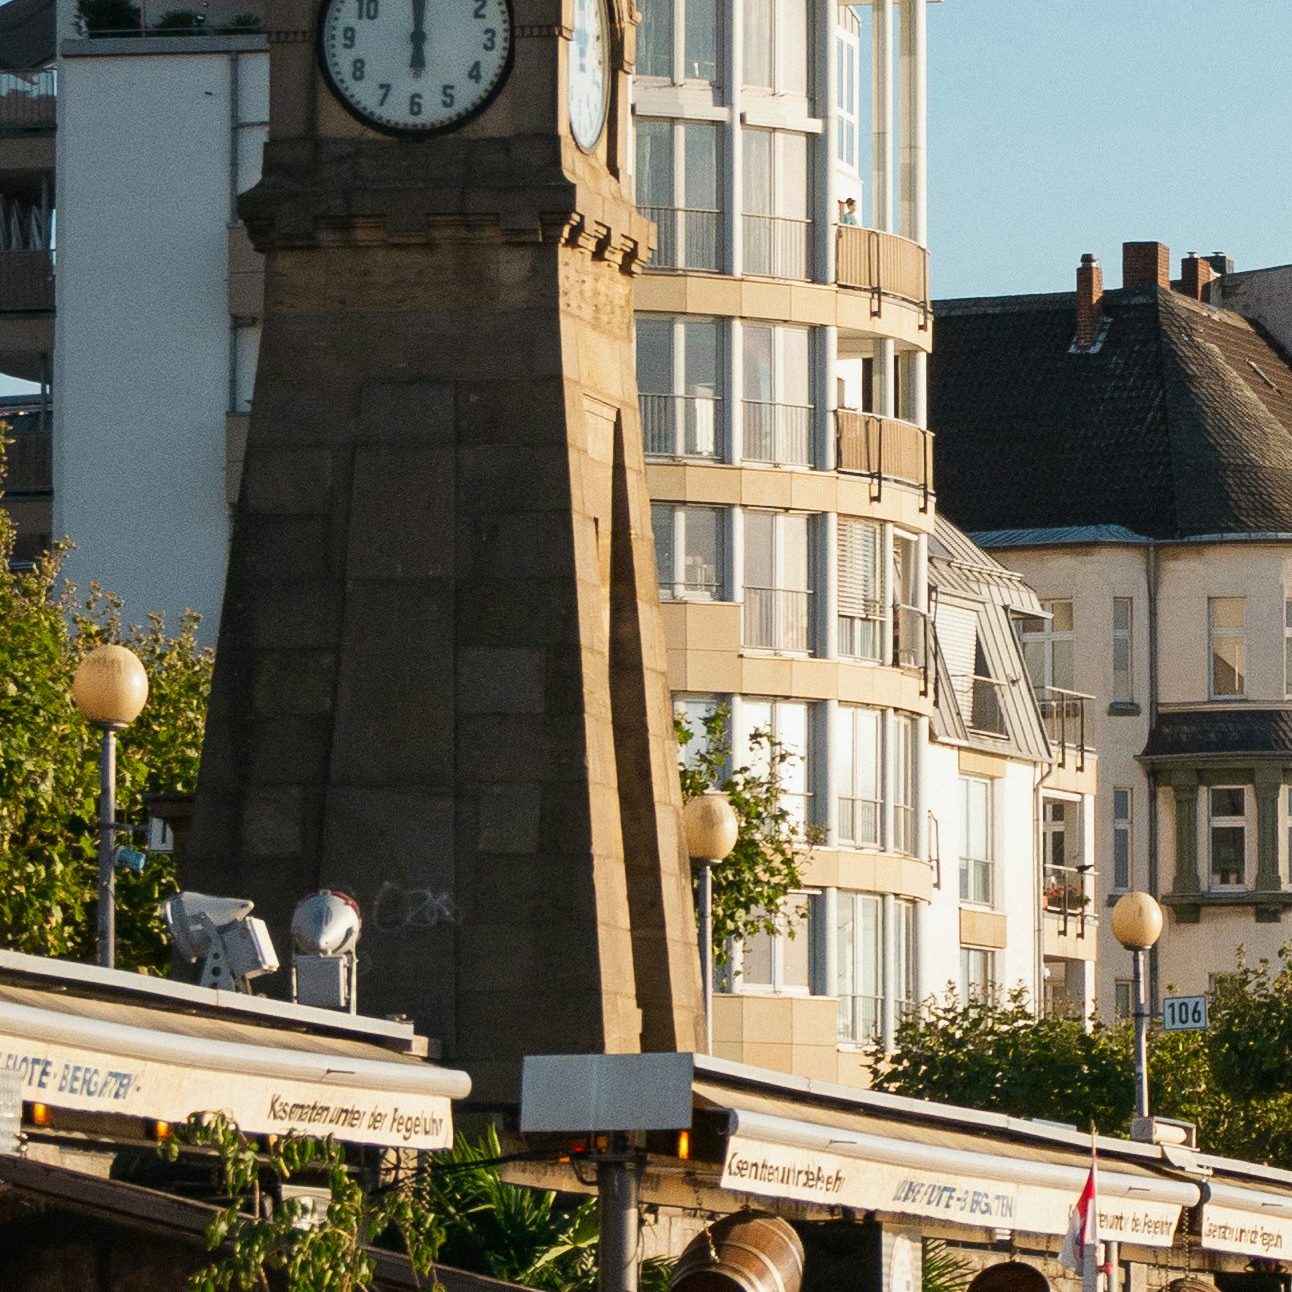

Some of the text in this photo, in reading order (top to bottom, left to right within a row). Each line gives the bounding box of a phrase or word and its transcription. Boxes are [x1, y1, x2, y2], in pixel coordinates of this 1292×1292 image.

[342, 27, 356, 49] 9
[483, 28, 496, 51] 3
[352, 58, 366, 81] 8
[467, 61, 481, 84] 4
[377, 83, 392, 107] 7
[409, 92, 423, 116] 6
[441, 85, 455, 108] 5
[1167, 1000, 1203, 1026] 106
